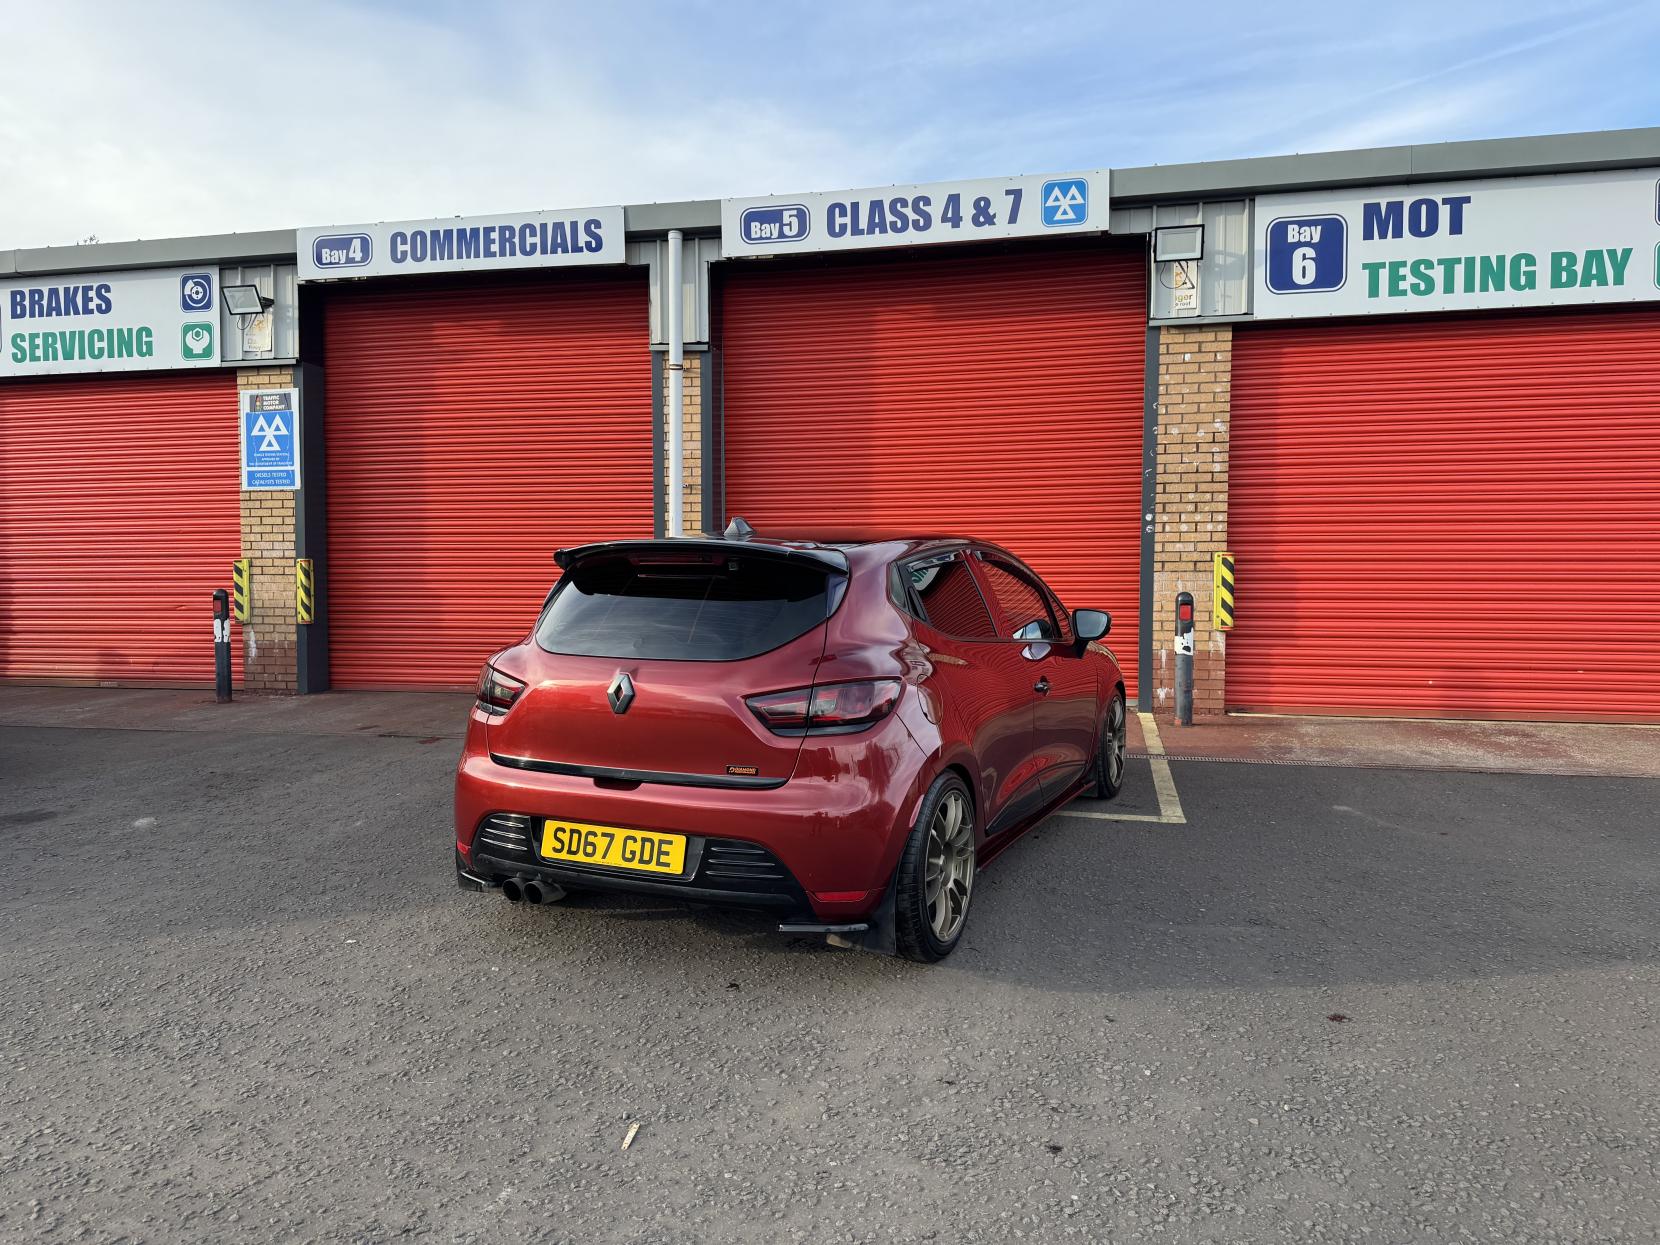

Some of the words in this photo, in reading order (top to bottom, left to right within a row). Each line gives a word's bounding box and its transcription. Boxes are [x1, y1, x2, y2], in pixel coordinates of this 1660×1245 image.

[750, 221, 779, 239] Bay
[782, 209, 799, 236] 5
[826, 195, 932, 239] CLASS
[940, 192, 963, 228] 4
[971, 196, 996, 227] &
[1004, 188, 1023, 224] 7
[1362, 195, 1472, 241] MOT
[321, 248, 347, 264] Bay
[348, 238, 363, 262] 4
[389, 218, 604, 264] COMMERCIALS
[1287, 223, 1322, 244] Bay
[1292, 246, 1317, 285] 6
[1361, 254, 1537, 299] TESTING
[1550, 247, 1634, 290] BAY
[10, 283, 112, 319] BRAKES
[11, 326, 154, 363] SERVICING
[552, 826, 616, 860] SD67
[621, 836, 674, 868] GDE
